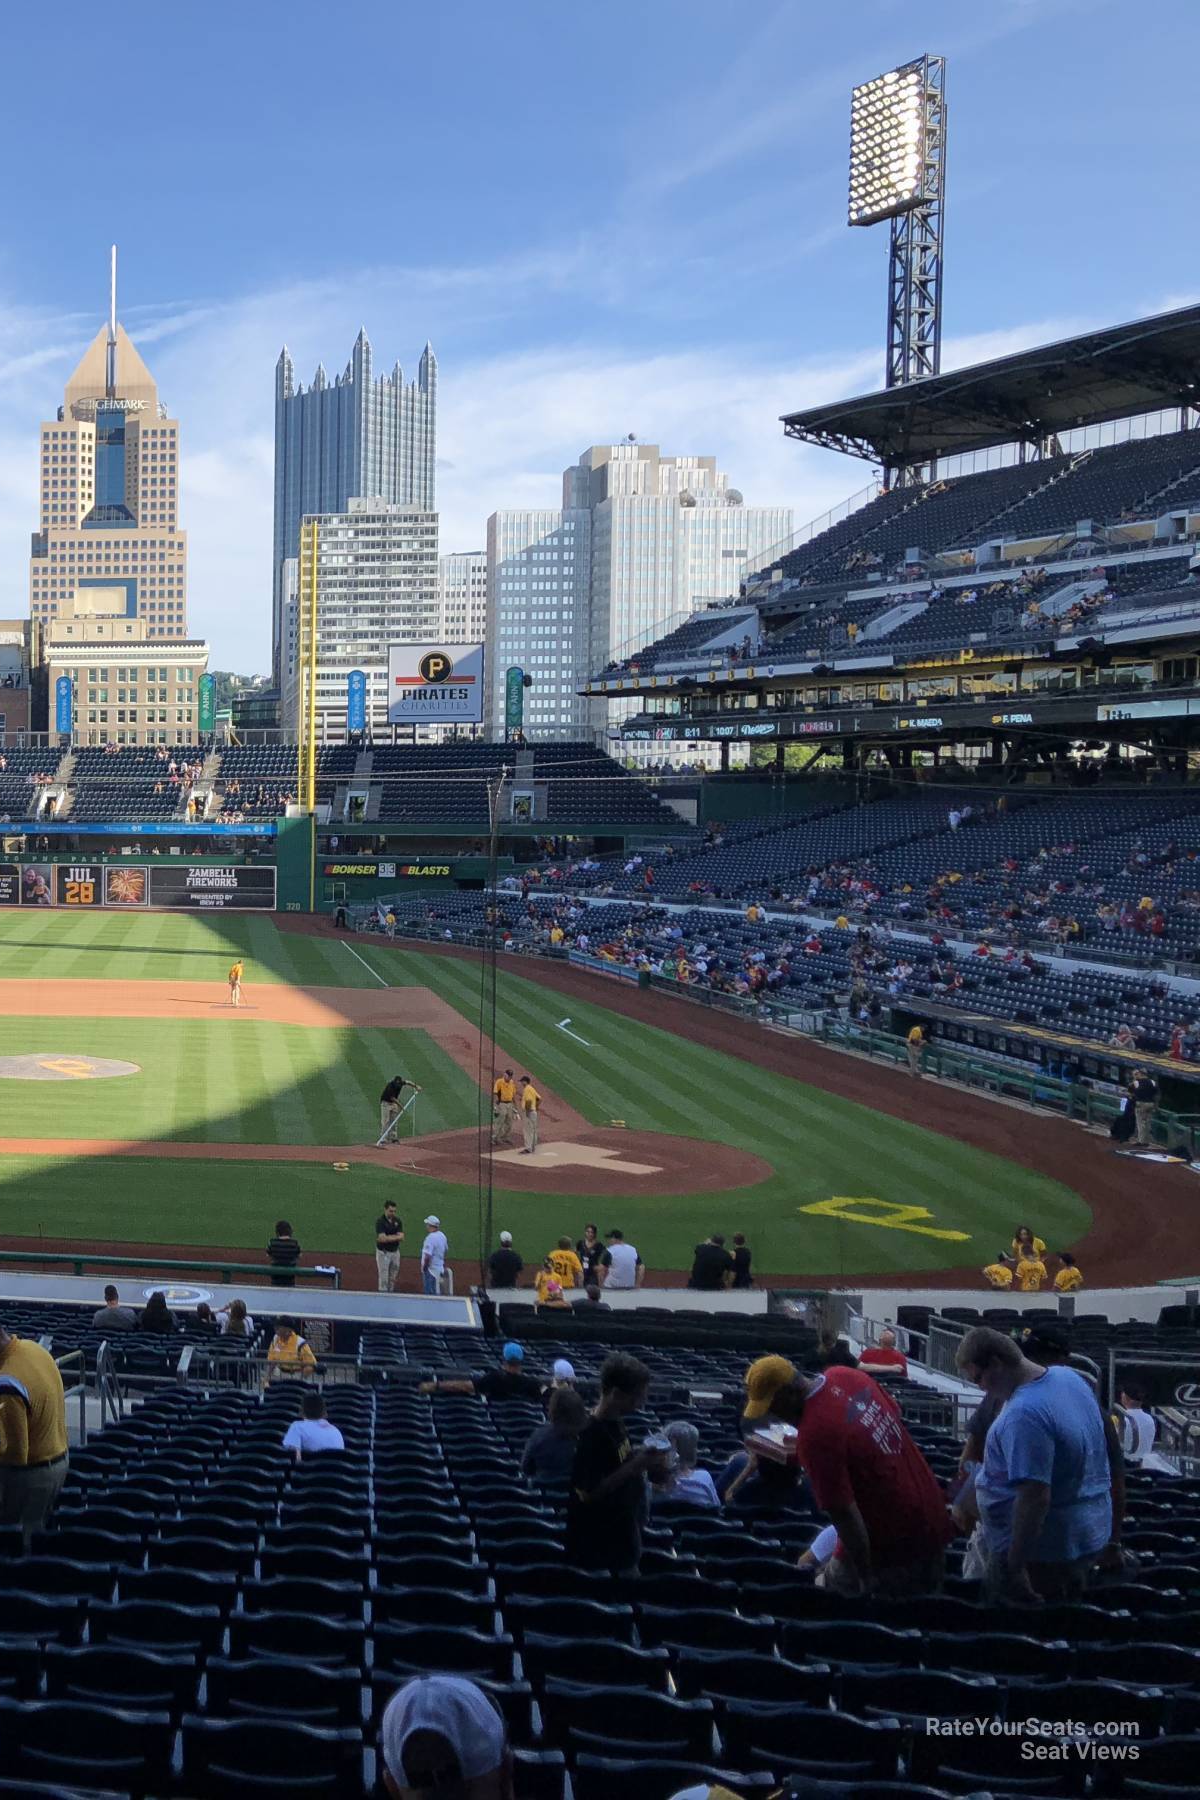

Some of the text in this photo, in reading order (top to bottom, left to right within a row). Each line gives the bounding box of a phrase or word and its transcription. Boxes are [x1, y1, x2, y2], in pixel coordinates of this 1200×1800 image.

[428, 658, 444, 678] P
[402, 688, 469, 701] PIRATES
[510, 686, 519, 704] AHN
[401, 701, 469, 710] CHARITIES
[917, 718, 943, 727] MAEDA
[1010, 714, 1033, 723] PENA
[188, 868, 235, 878] ZAMBELLI
[332, 865, 377, 875] BOWSER
[407, 866, 450, 875] BLASTS
[64, 868, 96, 883] JUL
[186, 877, 238, 887] FIREWORKS
[65, 882, 95, 904] 28
[286, 903, 301, 911] 320
[860, 1400, 881, 1428] HOME
